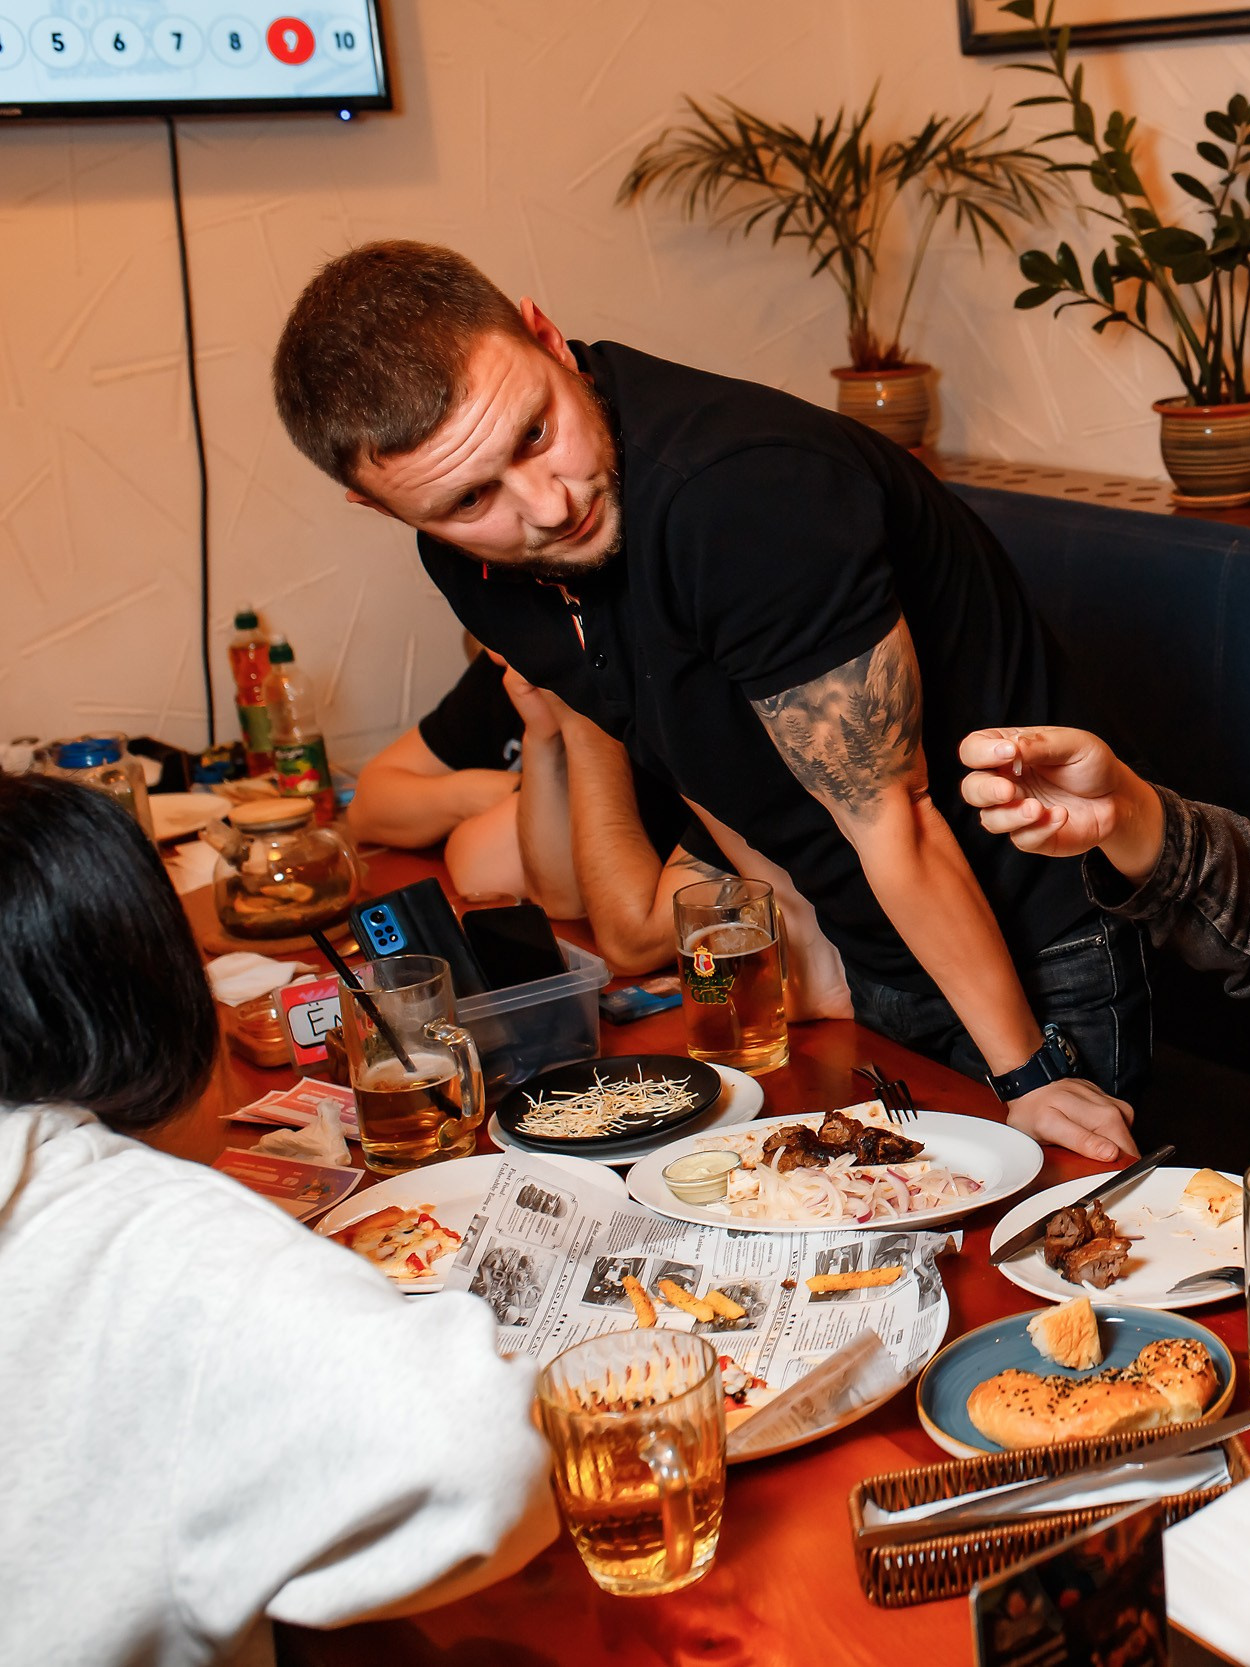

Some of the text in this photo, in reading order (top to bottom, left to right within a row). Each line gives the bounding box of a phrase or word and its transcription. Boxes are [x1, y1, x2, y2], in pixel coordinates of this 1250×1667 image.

[52, 32, 65, 52] 5
[113, 33, 126, 52] 6
[172, 33, 182, 51] 7
[230, 33, 242, 51] 8
[334, 32, 356, 50] 10
